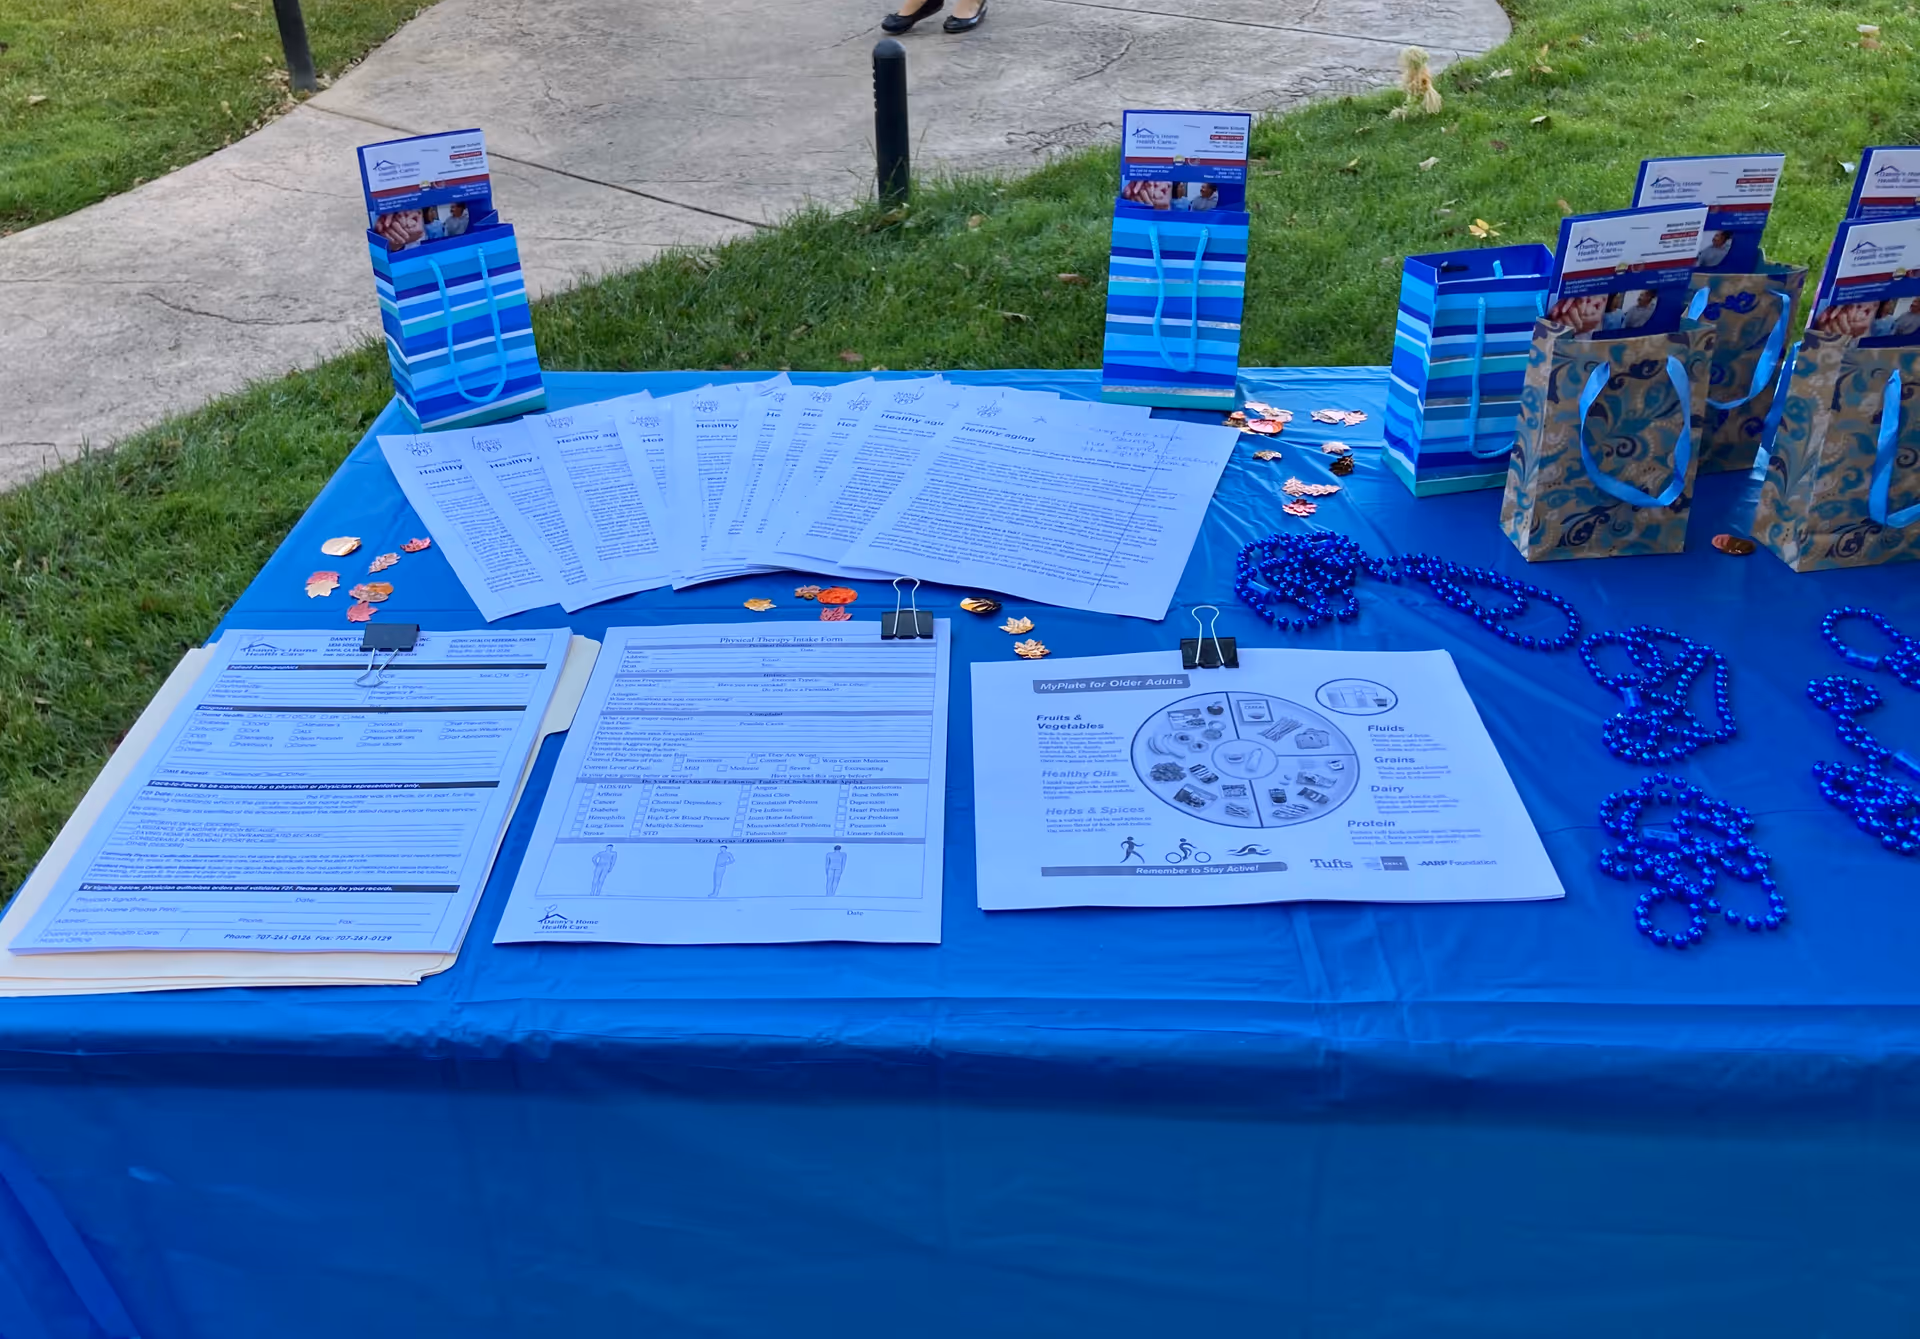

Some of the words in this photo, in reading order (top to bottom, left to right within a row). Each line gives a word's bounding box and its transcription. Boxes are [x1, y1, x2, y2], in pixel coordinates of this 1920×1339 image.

[880, 413, 922, 425] Healthy
[556, 433, 599, 445] Healthy
[960, 425, 1002, 437] Healthy
[1004, 433, 1037, 442] aging
[489, 456, 534, 469] Healthy
[418, 462, 464, 476] Healthy
[719, 636, 755, 644] Physical
[756, 636, 790, 644] Therapy
[792, 635, 820, 643] Intake
[820, 635, 844, 643] Form
[1040, 681, 1087, 691] MyPlate
[1089, 680, 1106, 689] for
[1109, 679, 1143, 688] Older
[1145, 677, 1184, 686] Adults
[1037, 722, 1105, 731] Vegetables
[1367, 724, 1405, 732] Fluids
[1374, 756, 1416, 764] Grains
[1041, 769, 1091, 779] Healthy
[1093, 769, 1119, 778] Oils
[1370, 785, 1405, 794] Dairy
[1045, 807, 1085, 816] Herbs
[1087, 806, 1097, 815] &
[1100, 805, 1146, 816] Spices
[1347, 820, 1396, 828] Protein
[1309, 858, 1354, 869] Tufts
[1136, 867, 1189, 875] Remember
[1203, 866, 1224, 875] Stay
[1226, 864, 1260, 873] Active!
[255, 933, 312, 941] 707-261-0126
